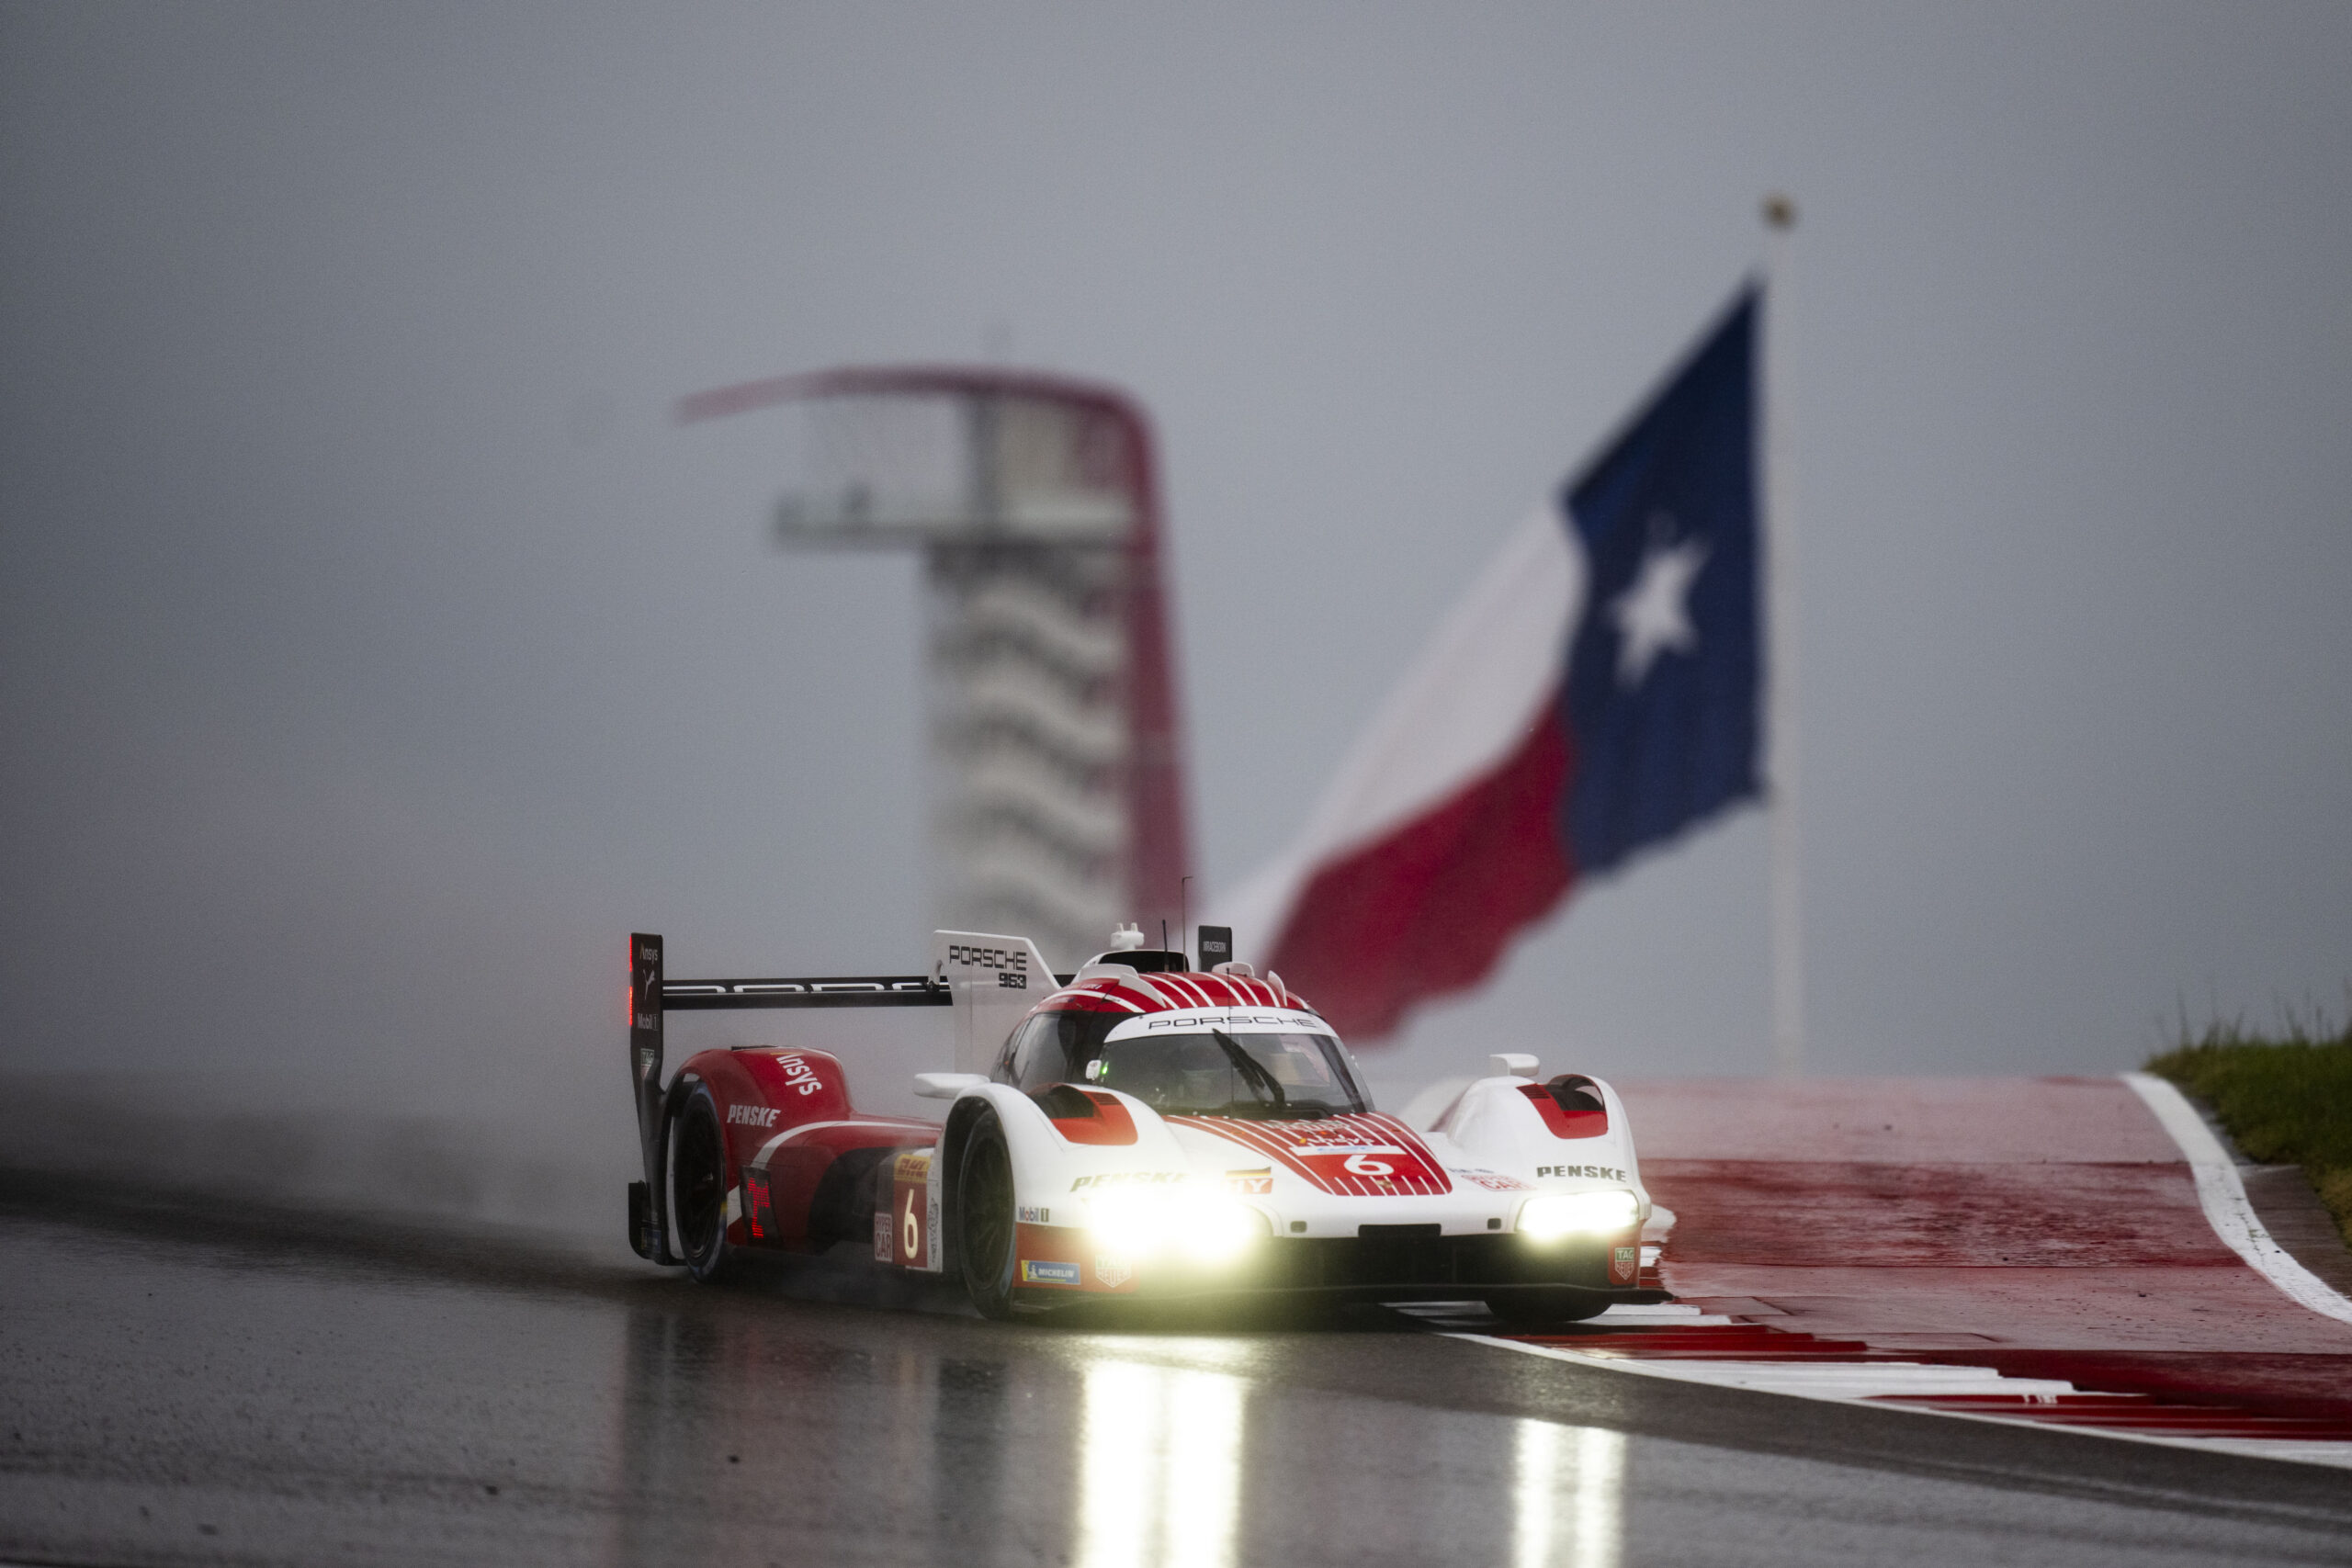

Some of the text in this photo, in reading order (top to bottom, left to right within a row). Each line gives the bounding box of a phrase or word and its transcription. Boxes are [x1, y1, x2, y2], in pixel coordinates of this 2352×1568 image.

[949, 944, 1027, 971] PORSCHE
[999, 972, 1027, 990] 963
[637, 1012, 652, 1030] Mobil
[1148, 1016, 1317, 1030] PORSCHE
[727, 1104, 782, 1128] PENSKE
[1343, 1154, 1395, 1176] 6
[1535, 1165, 1627, 1183] PENSKE
[1018, 1206, 1040, 1223] Mobil
[904, 1189, 919, 1259] 6
[876, 1232, 892, 1258] CAR
[1038, 1268, 1076, 1279] MICHELIN
